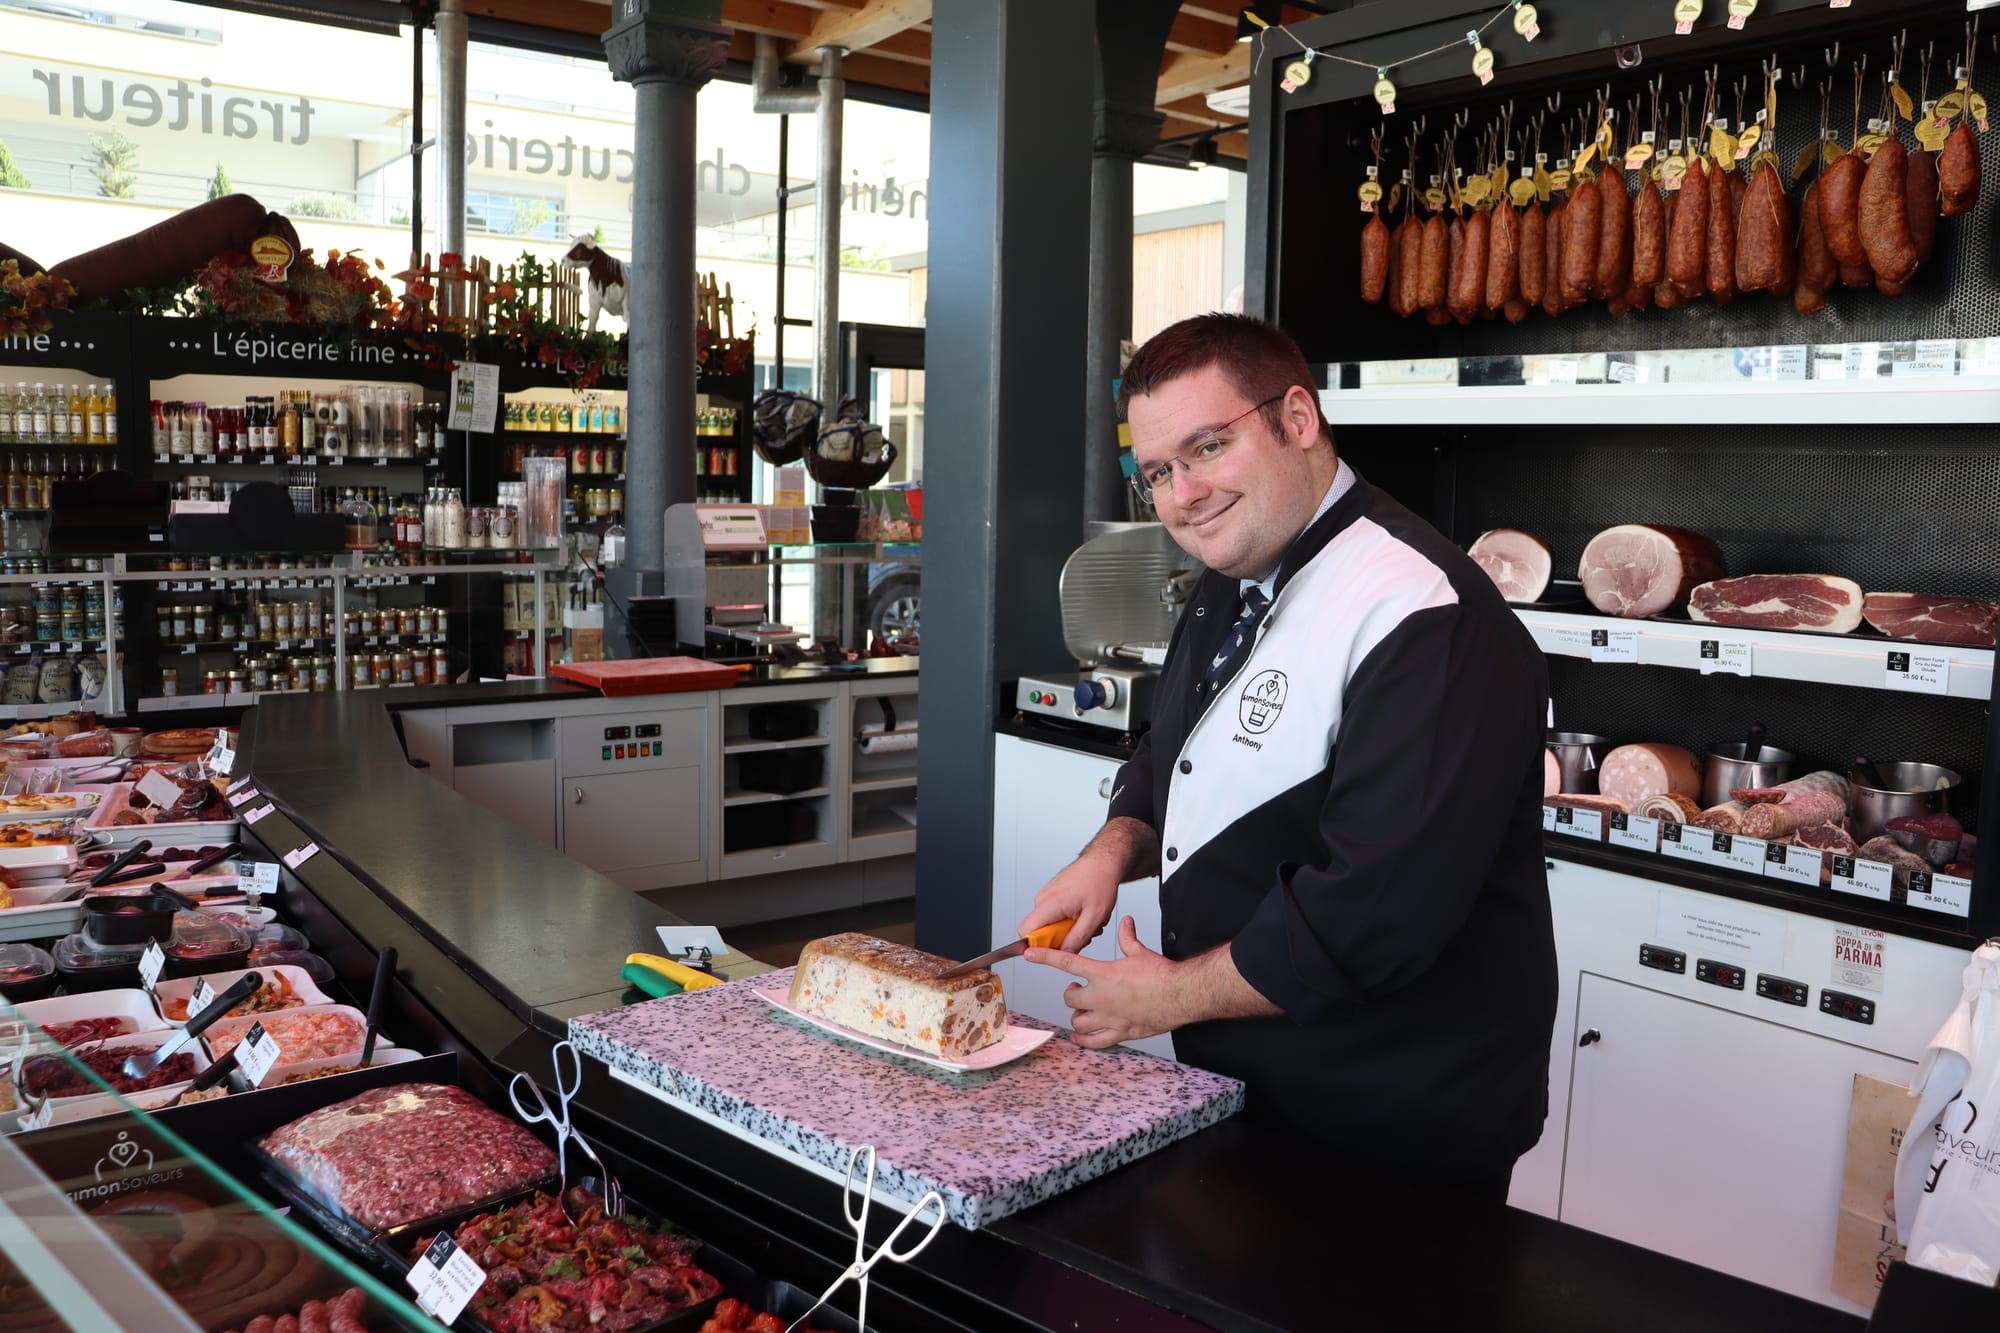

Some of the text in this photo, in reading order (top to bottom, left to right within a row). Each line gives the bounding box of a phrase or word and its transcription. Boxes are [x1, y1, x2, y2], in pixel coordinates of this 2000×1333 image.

[213, 331, 395, 364] L'épicerie fine
[1232, 734, 1262, 752] Anthony
[1836, 935, 1872, 951] COPPA DI
[1861, 929, 1885, 939] LEVONI
[1836, 946, 1882, 968] PARMA
